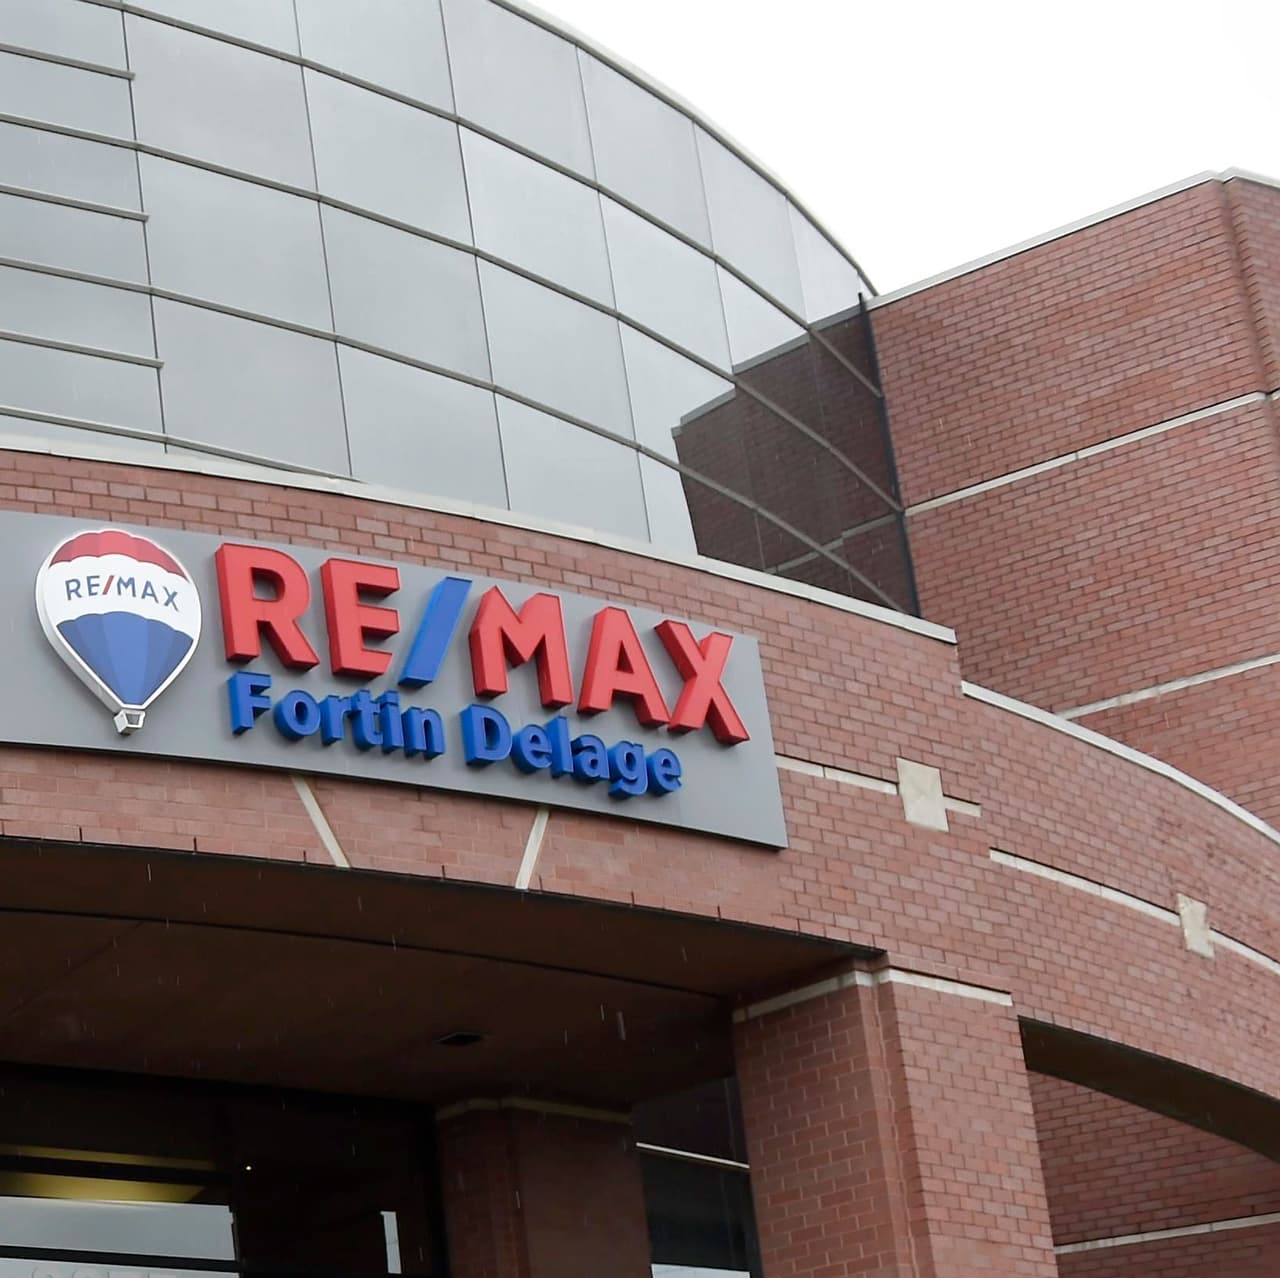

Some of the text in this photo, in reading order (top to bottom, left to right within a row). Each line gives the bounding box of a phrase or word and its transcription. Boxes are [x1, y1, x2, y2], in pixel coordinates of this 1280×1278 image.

[64, 574, 180, 612] RE/MAX
[215, 542, 751, 746] RE/MAX
[227, 671, 683, 799] Fortin Delage
